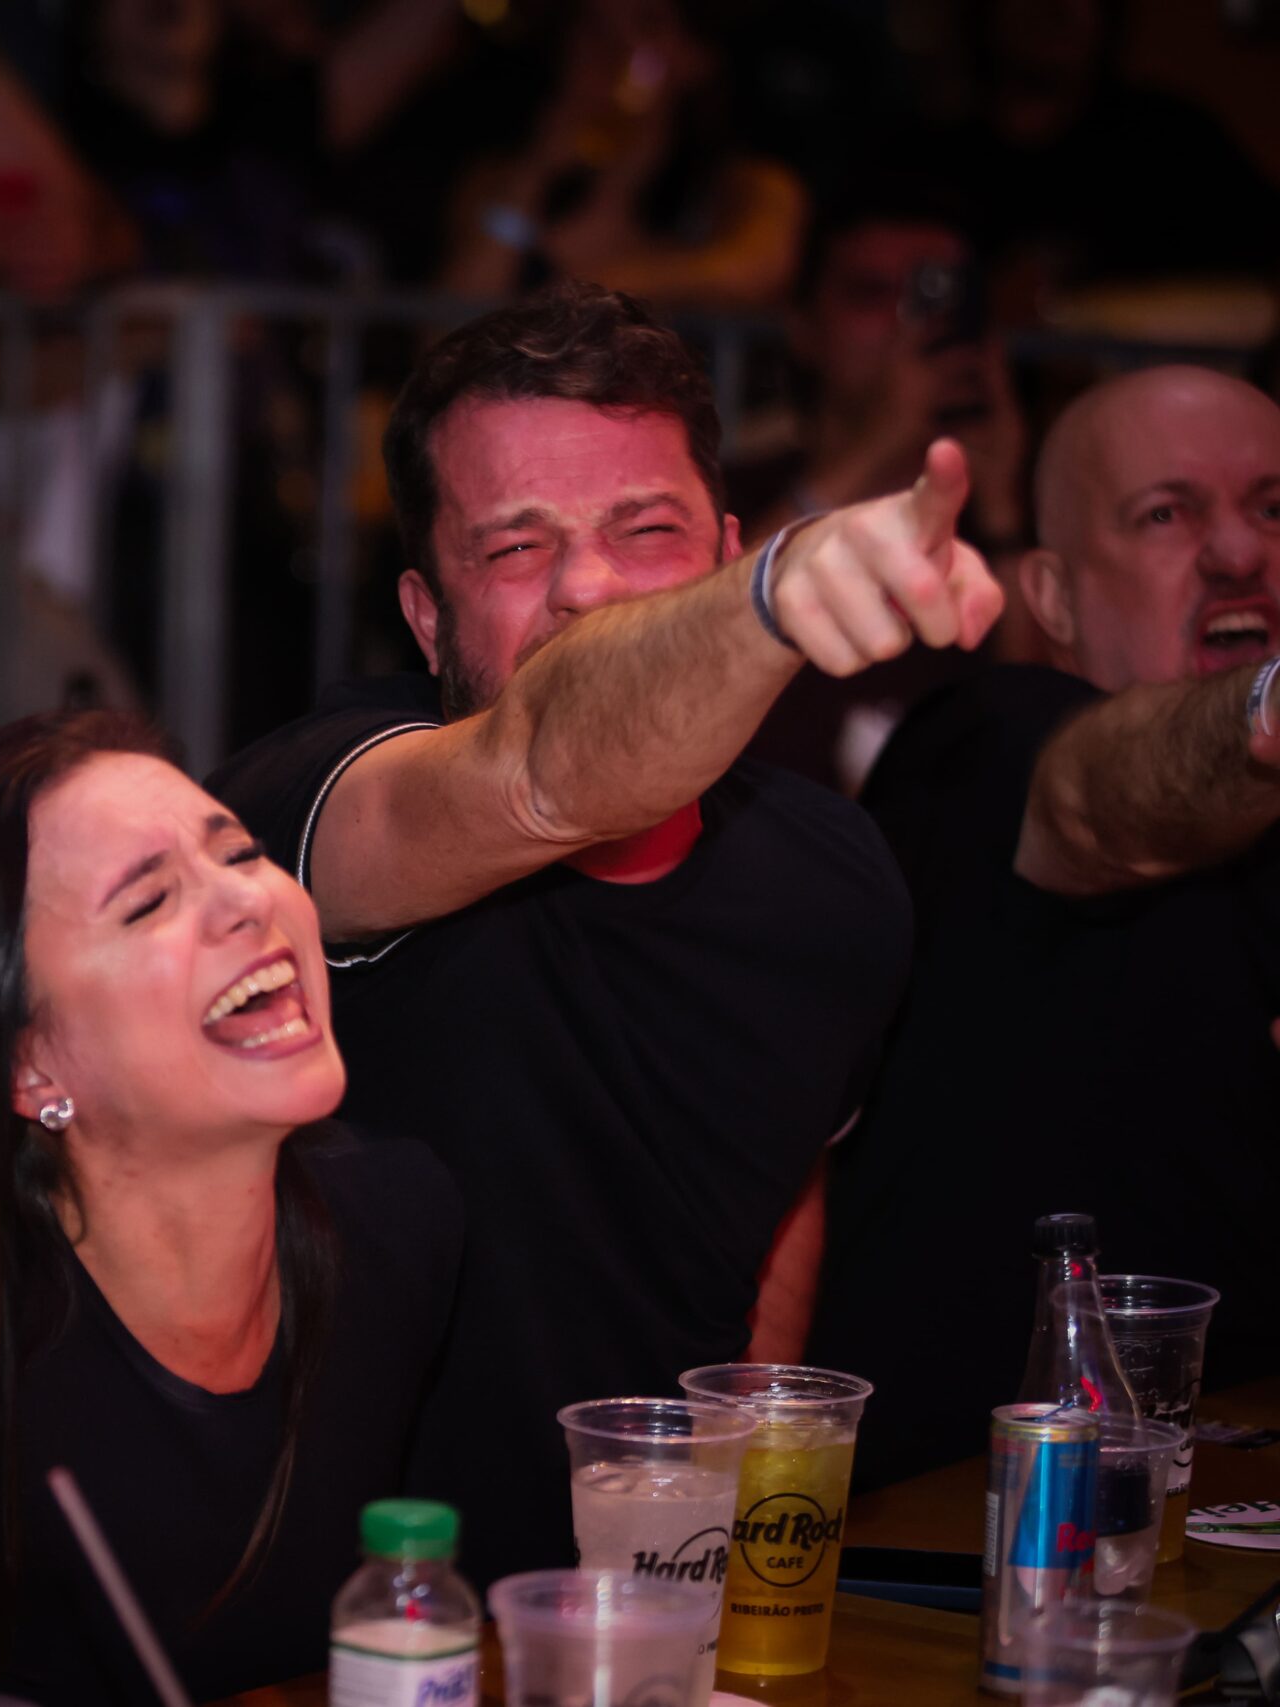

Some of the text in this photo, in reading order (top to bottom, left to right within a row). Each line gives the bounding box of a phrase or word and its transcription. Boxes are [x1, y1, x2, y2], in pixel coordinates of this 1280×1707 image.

[731, 1512, 789, 1545] ard
[633, 1548, 712, 1583] Hard
[766, 1556, 804, 1569] CAFE
[730, 1602, 791, 1617] RIBEIRÃO
